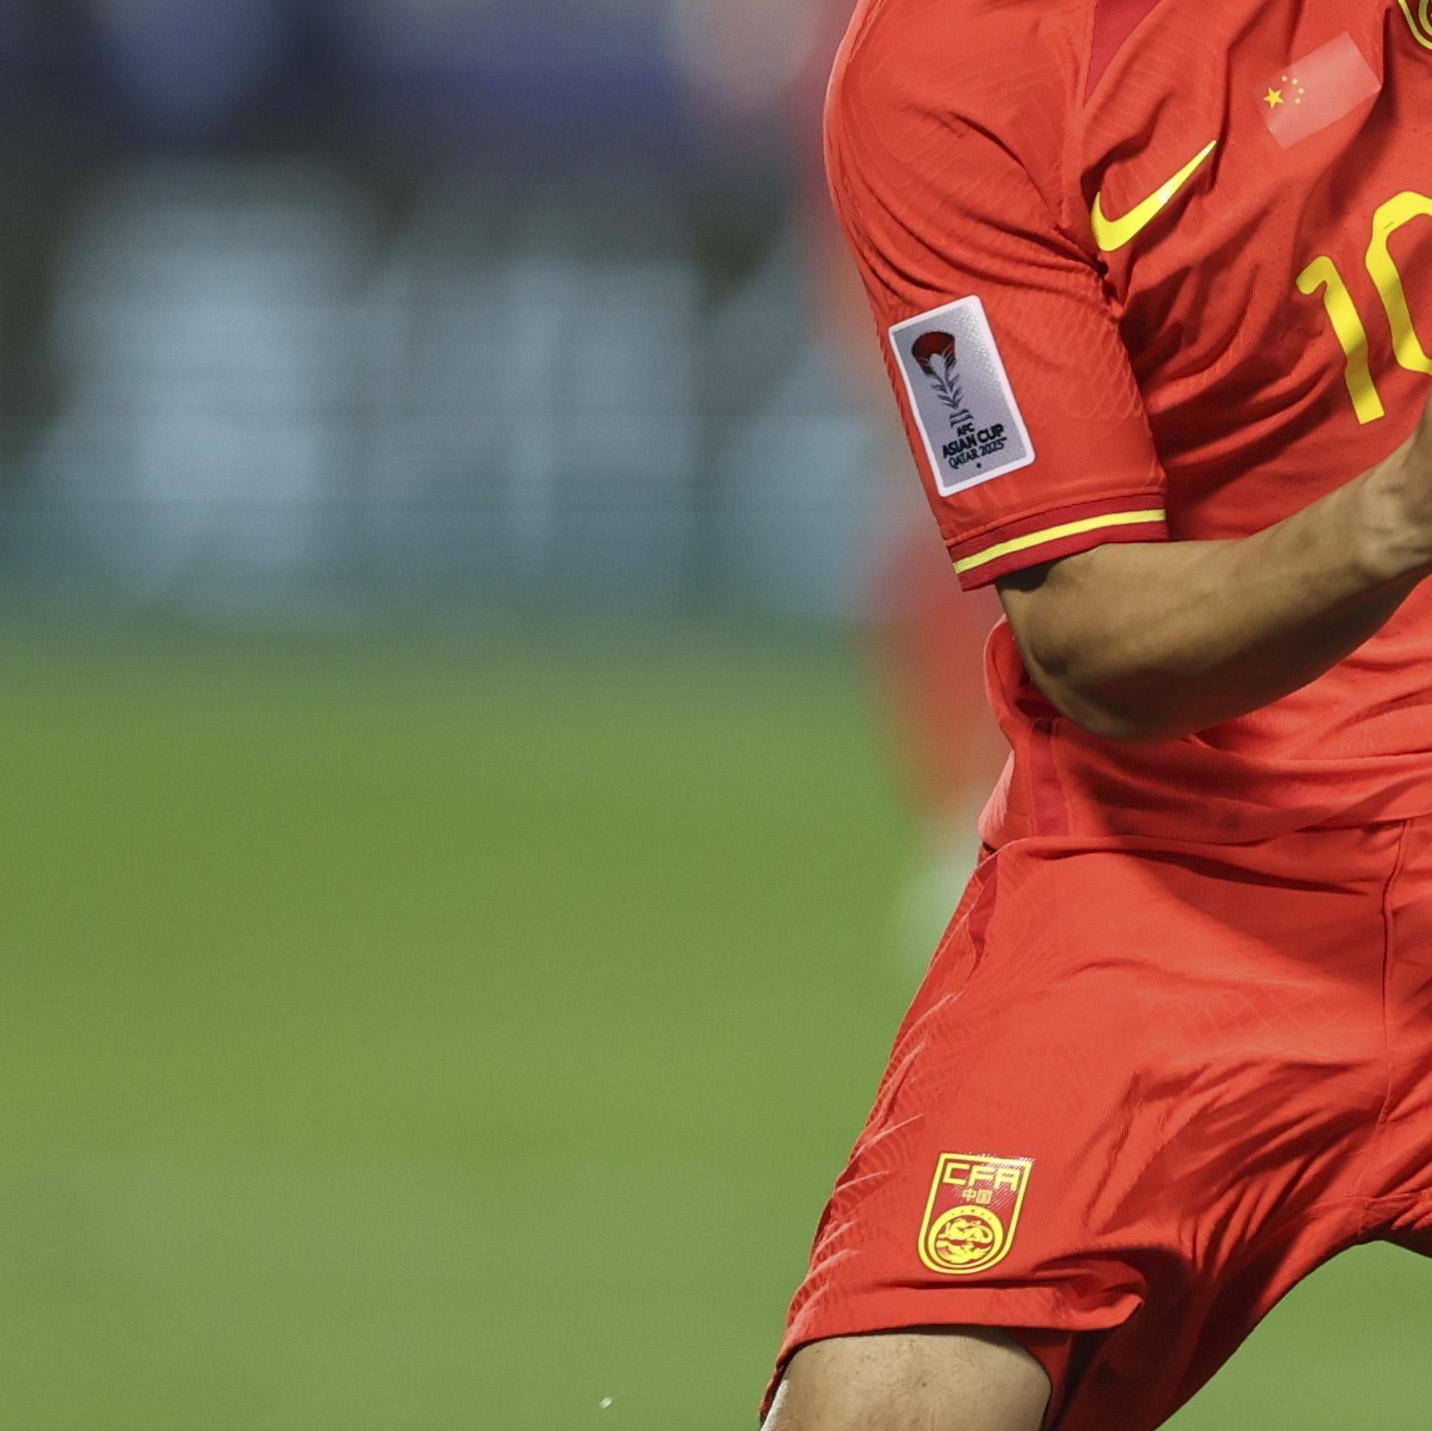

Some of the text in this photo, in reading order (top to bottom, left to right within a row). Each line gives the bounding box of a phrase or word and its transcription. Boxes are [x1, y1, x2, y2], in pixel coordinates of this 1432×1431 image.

[942, 423, 1004, 458] ASIAN CUP
[956, 422, 975, 437] AFC
[948, 448, 979, 469] QATAR
[942, 1161, 1021, 1192] CFA
